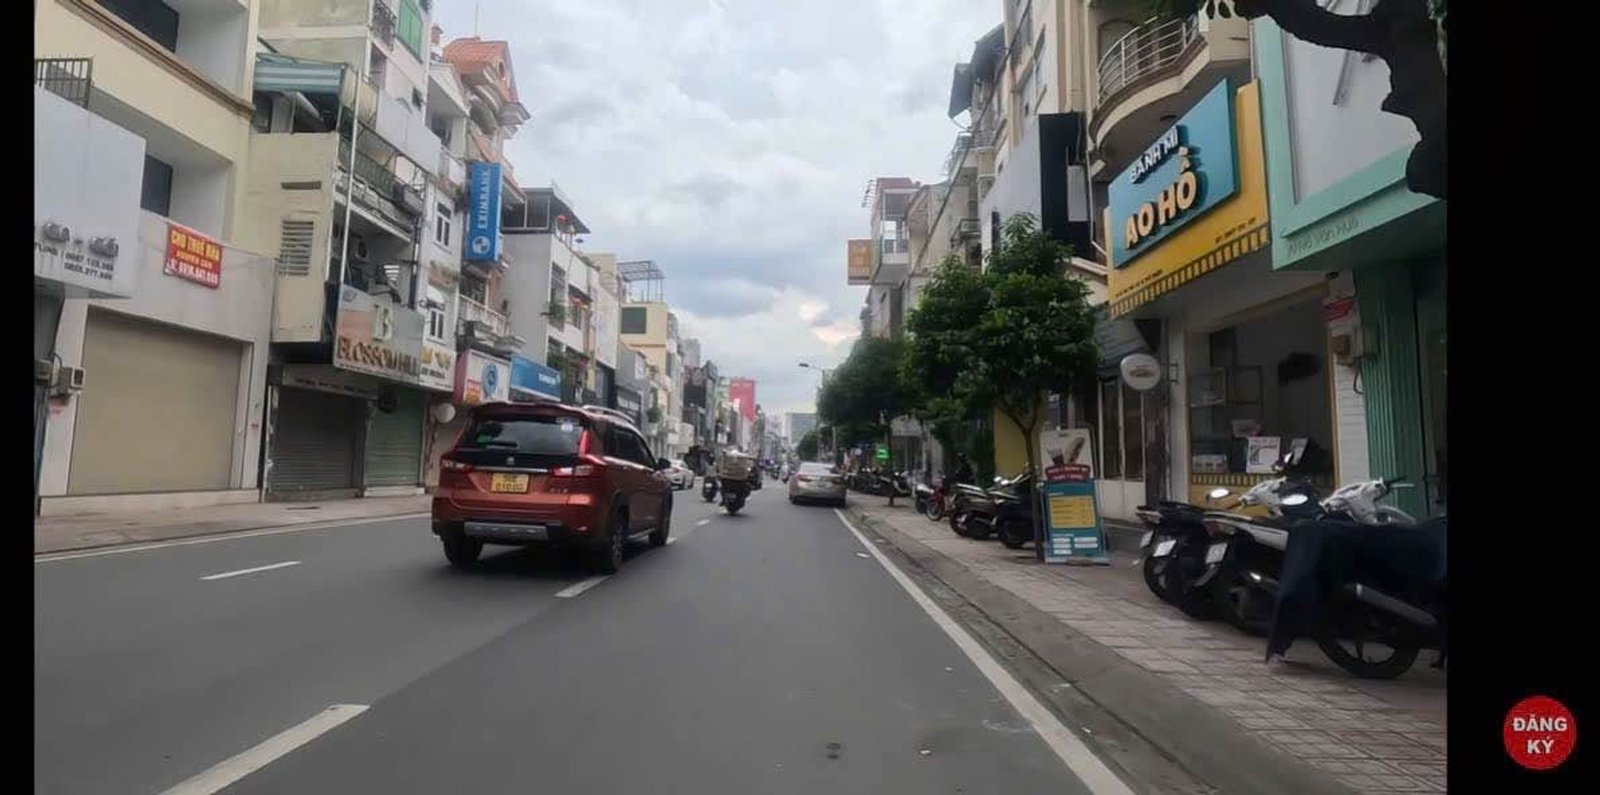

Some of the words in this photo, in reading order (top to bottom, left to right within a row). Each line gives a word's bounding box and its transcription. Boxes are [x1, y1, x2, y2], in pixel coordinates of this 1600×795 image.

[478, 168, 491, 229] EXIMBANK
[1126, 201, 1155, 249] AO
[337, 336, 398, 370] BLOSSOM
